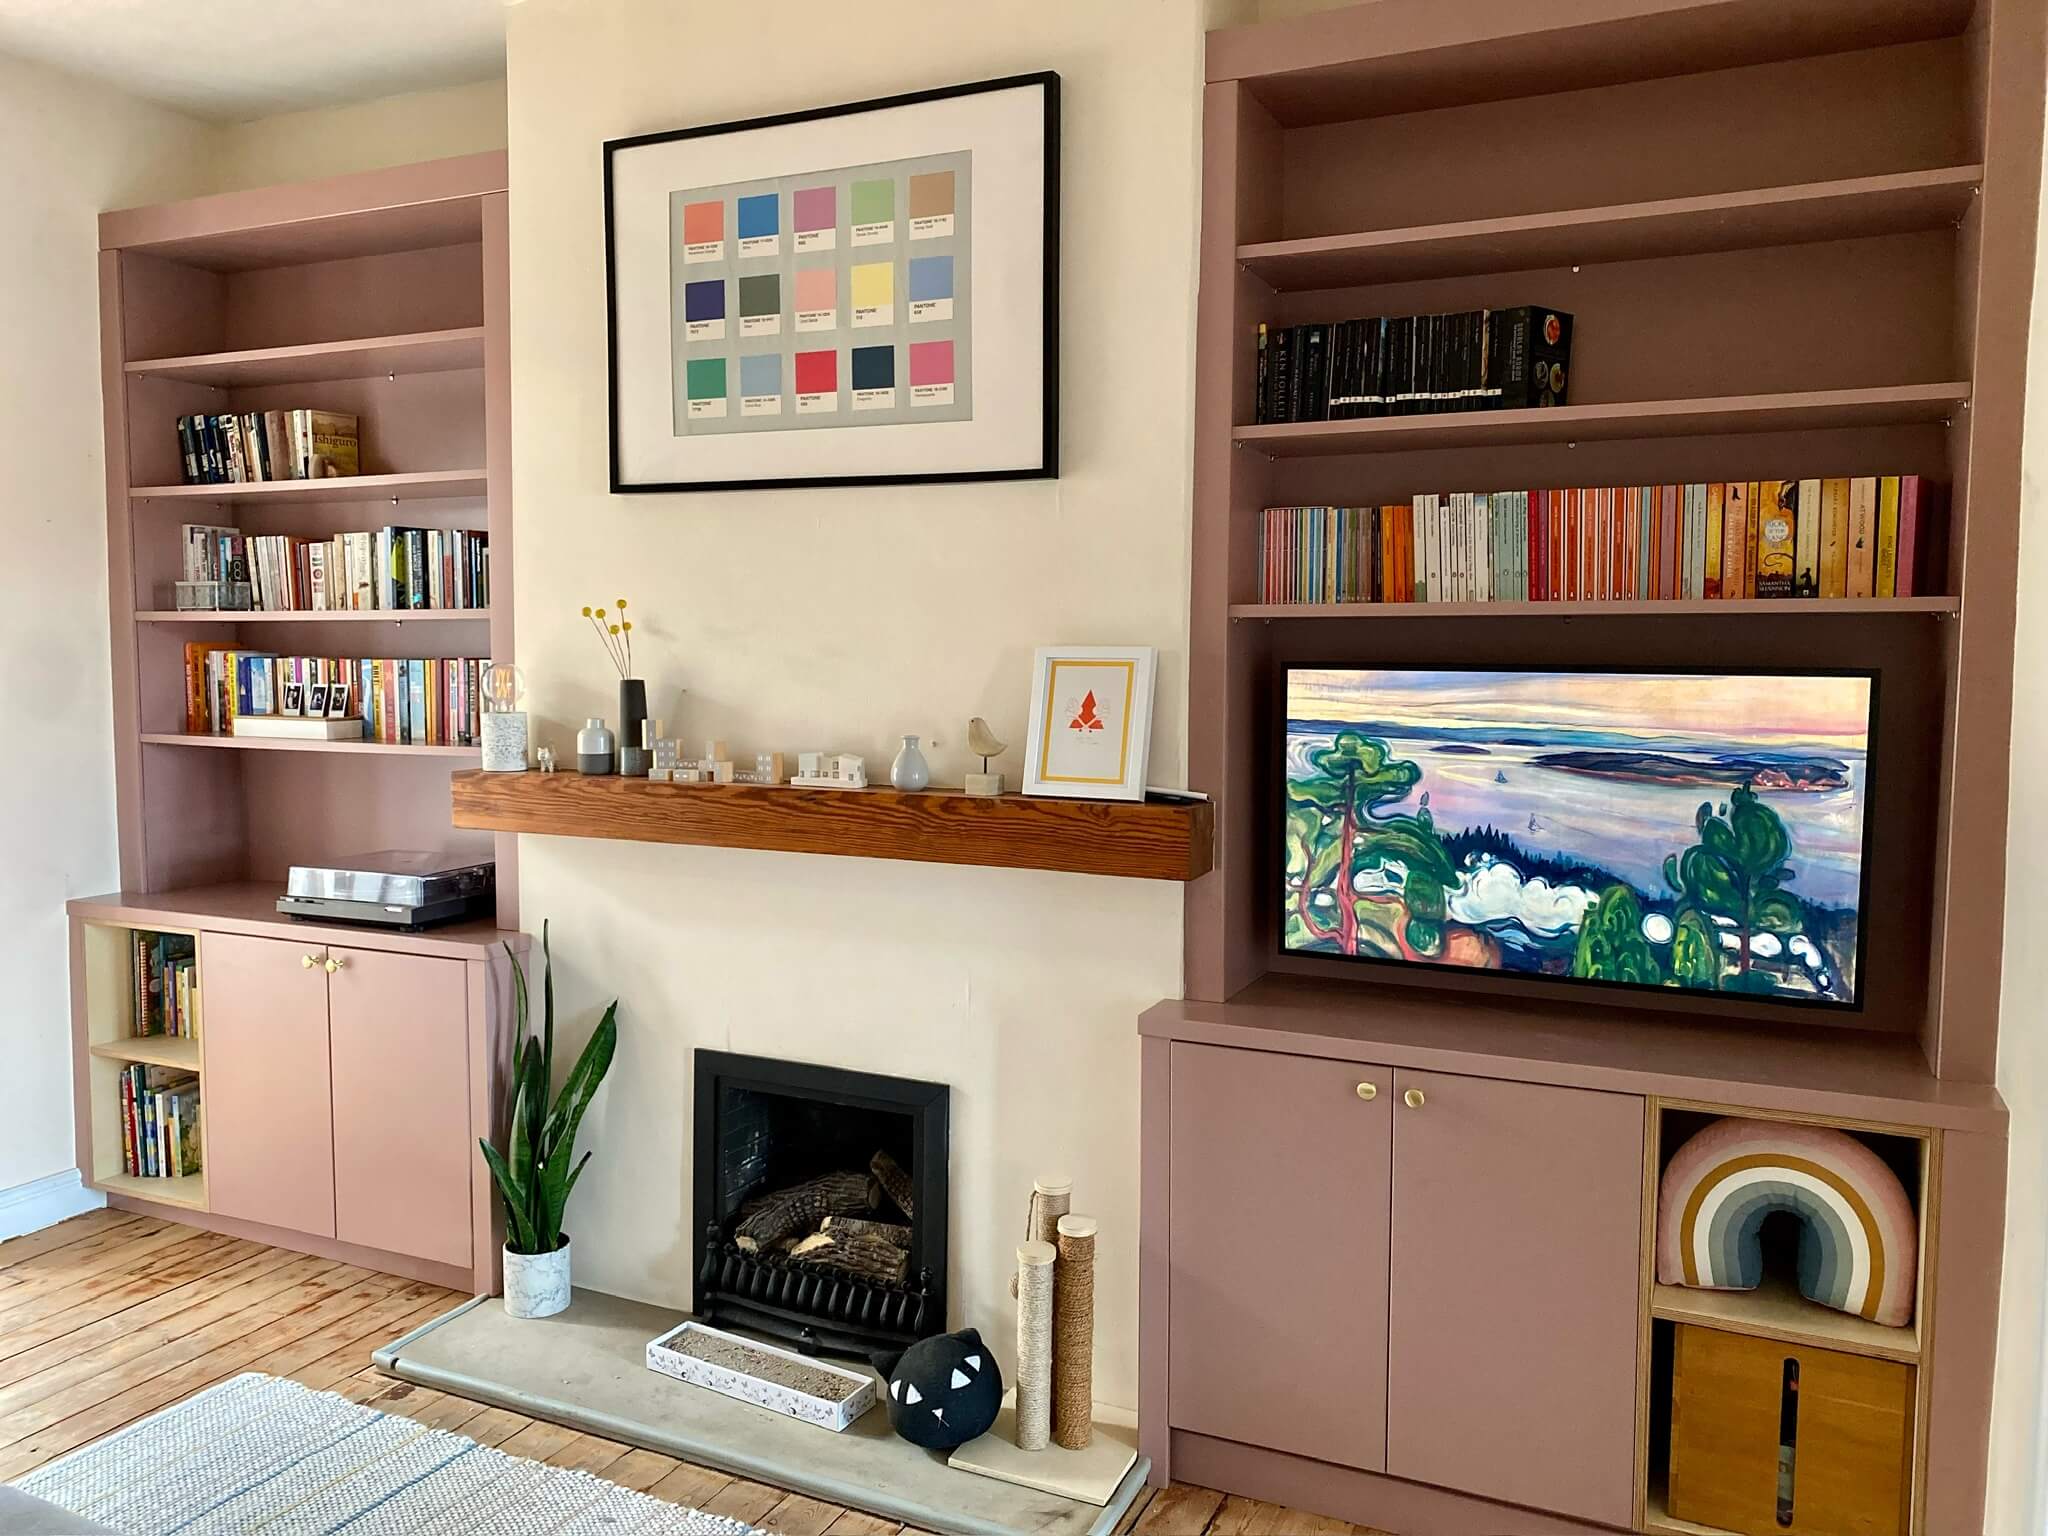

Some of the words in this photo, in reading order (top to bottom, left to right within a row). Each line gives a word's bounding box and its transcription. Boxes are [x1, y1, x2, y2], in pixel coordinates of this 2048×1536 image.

[1278, 350, 1288, 370] KEN
[1515, 356, 1523, 381] ADAMS
[1277, 375, 1287, 418] FOLLETT
[314, 433, 357, 449] Ishiguro
[1858, 504, 1866, 535] ATWOOD
[185, 664, 191, 675] NO
